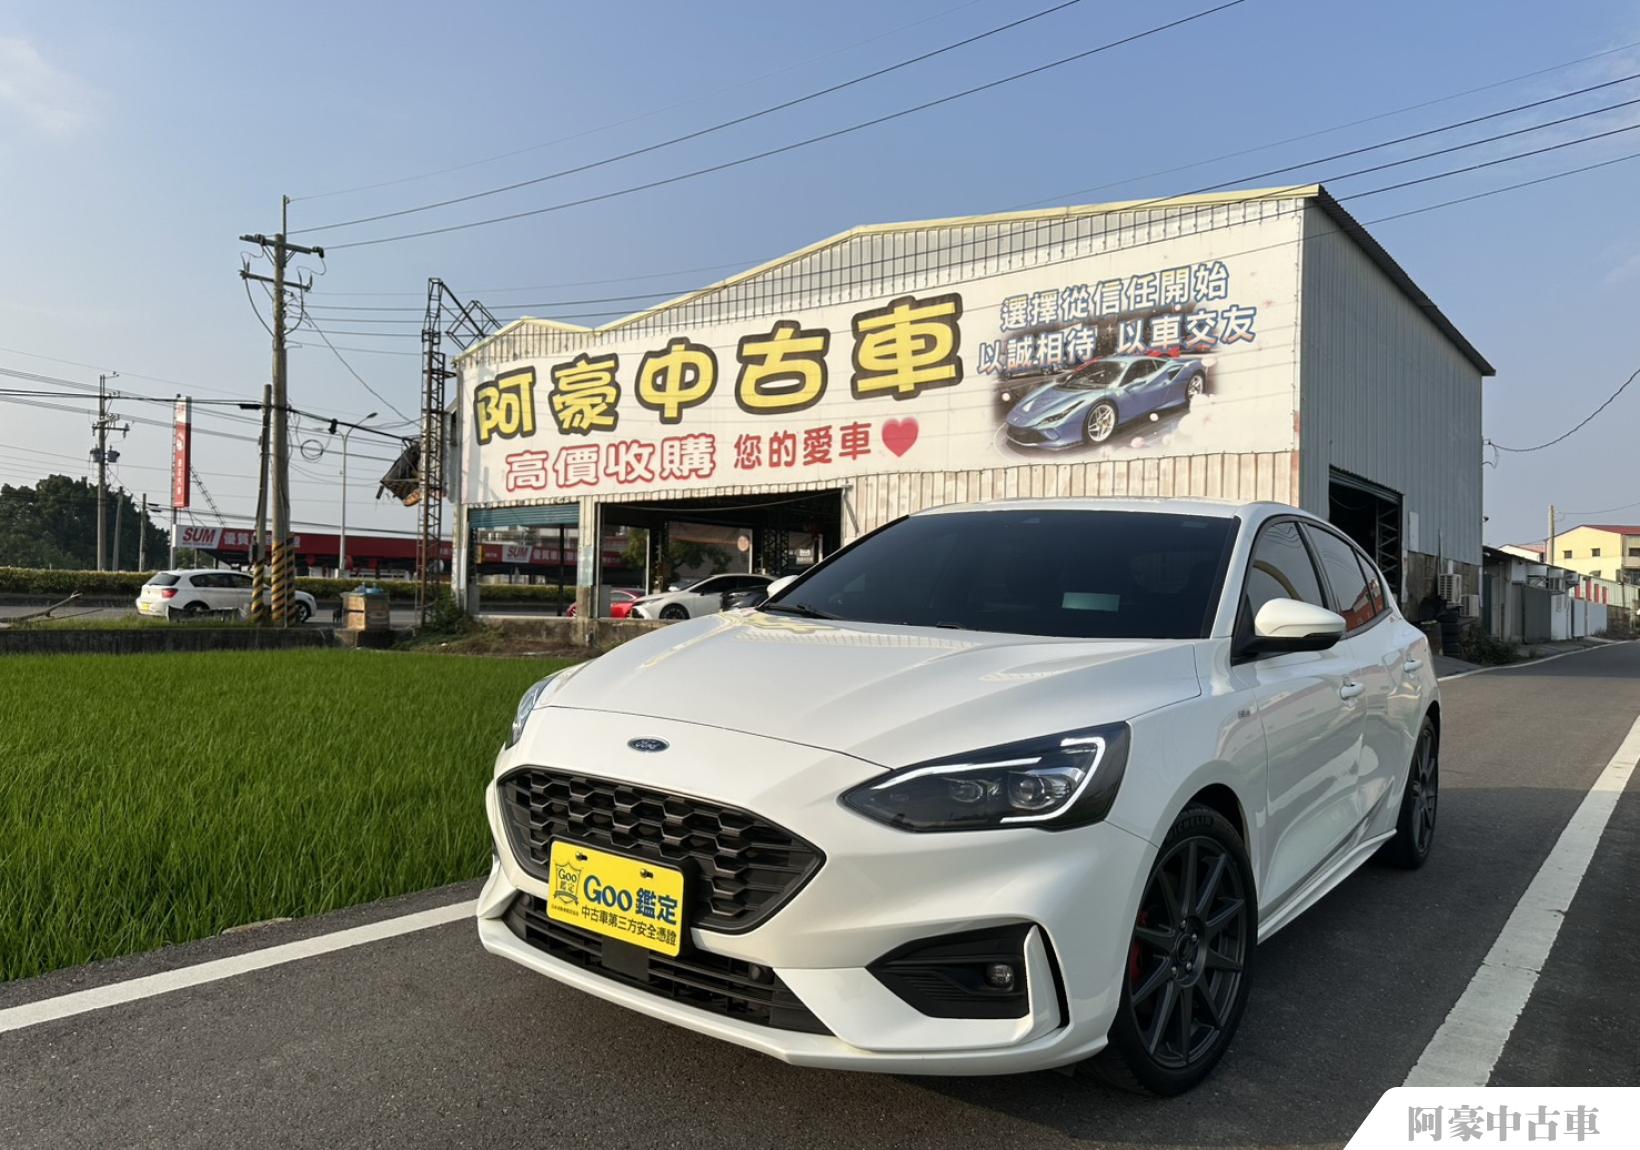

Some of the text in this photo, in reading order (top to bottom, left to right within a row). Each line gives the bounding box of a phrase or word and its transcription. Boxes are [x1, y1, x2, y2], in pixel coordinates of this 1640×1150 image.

[1000, 261, 1230, 331] 選擇從信任開始
[474, 292, 963, 444] 阿豪中古車
[978, 304, 1256, 374] 以誠相待 以車交友
[505, 421, 872, 492] 高價收購 您的愛車
[183, 526, 216, 544] SUM
[558, 868, 577, 883] Goo
[583, 874, 678, 926] Goo 鑑定
